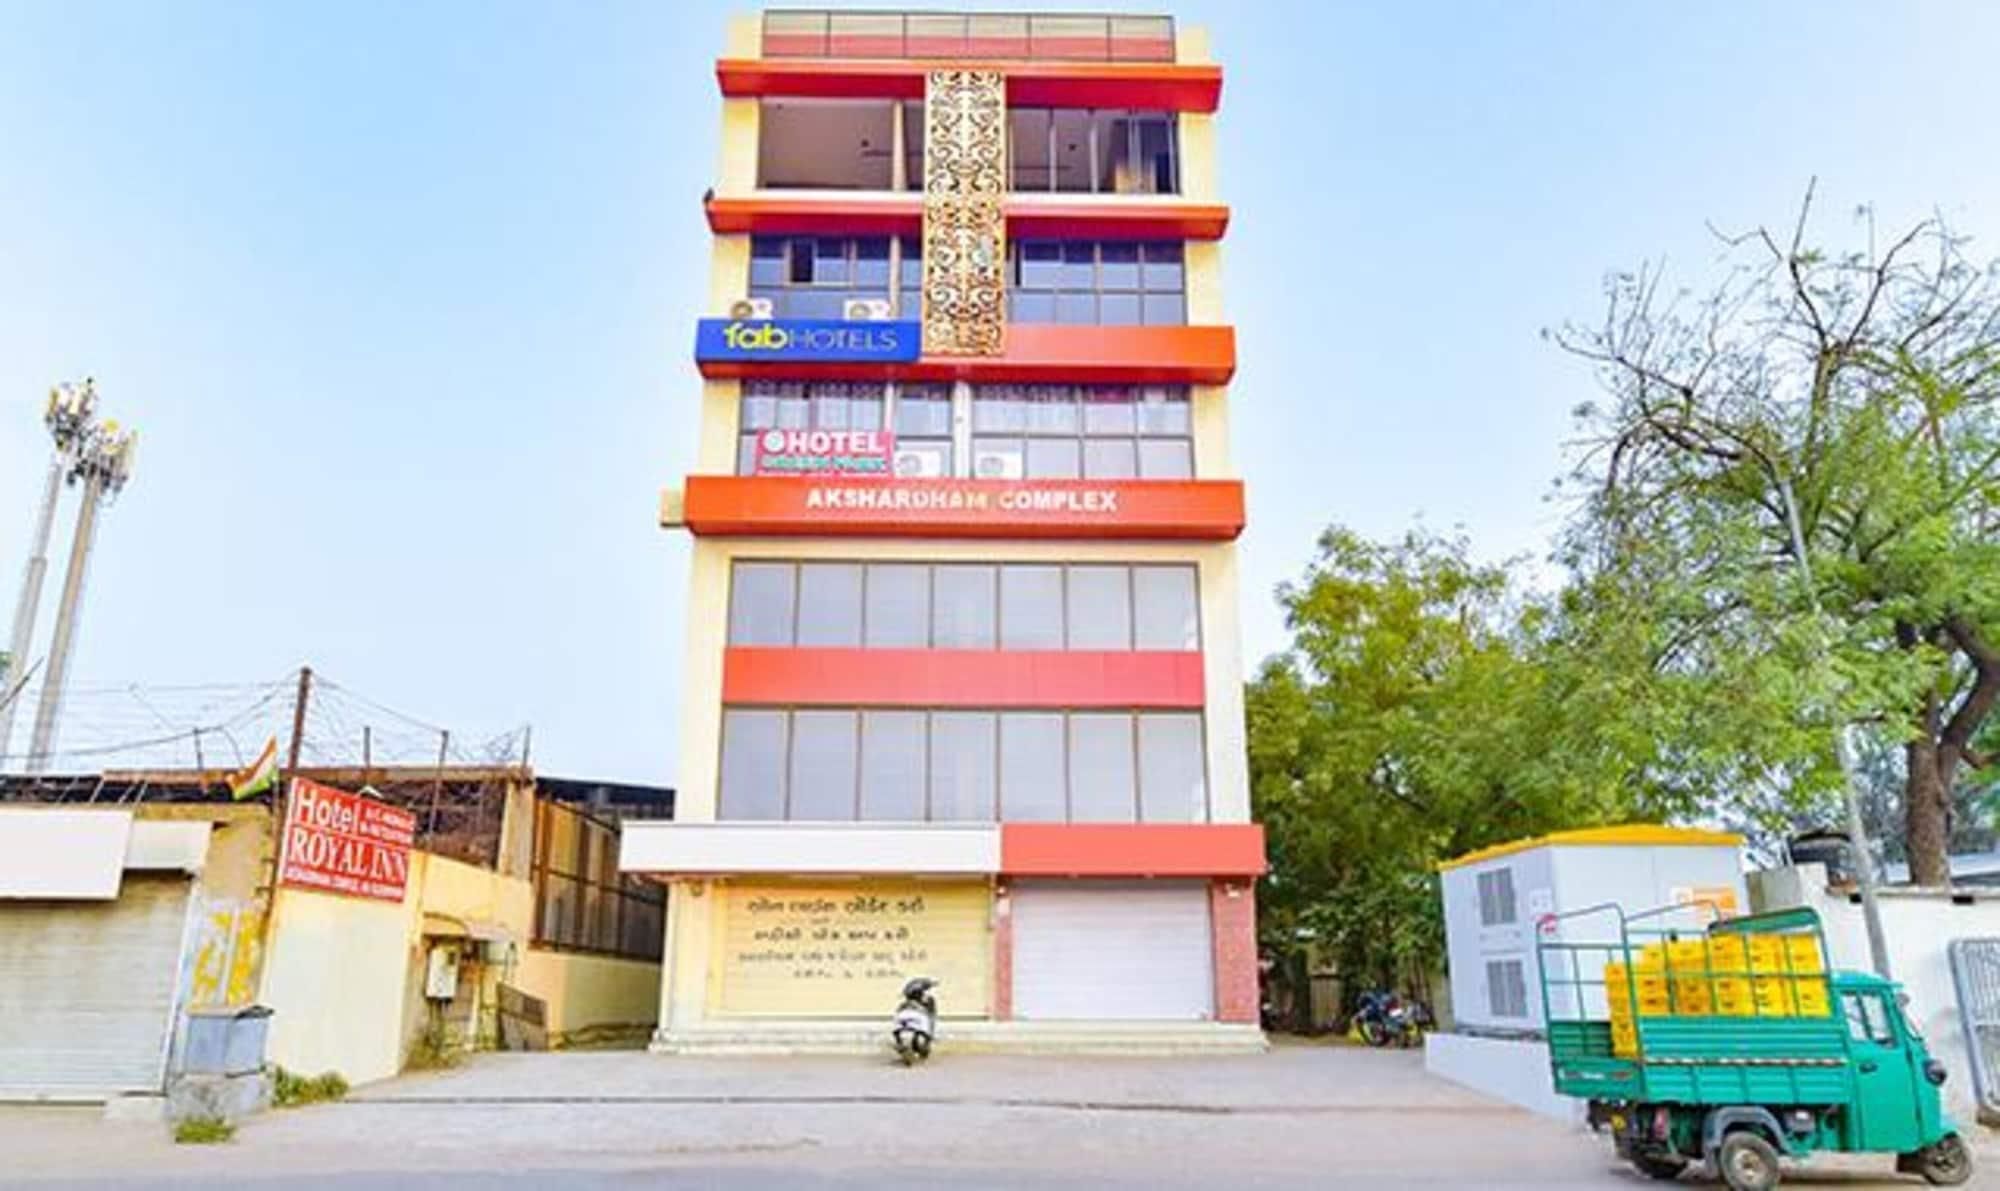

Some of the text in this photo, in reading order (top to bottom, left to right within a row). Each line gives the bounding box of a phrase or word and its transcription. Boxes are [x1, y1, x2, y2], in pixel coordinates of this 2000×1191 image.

[787, 431, 886, 454] HOTEL
[805, 487, 1118, 512] AKSHARDHAM COMPLEX
[294, 784, 359, 836] Hotel
[289, 828, 369, 876] ROYAL
